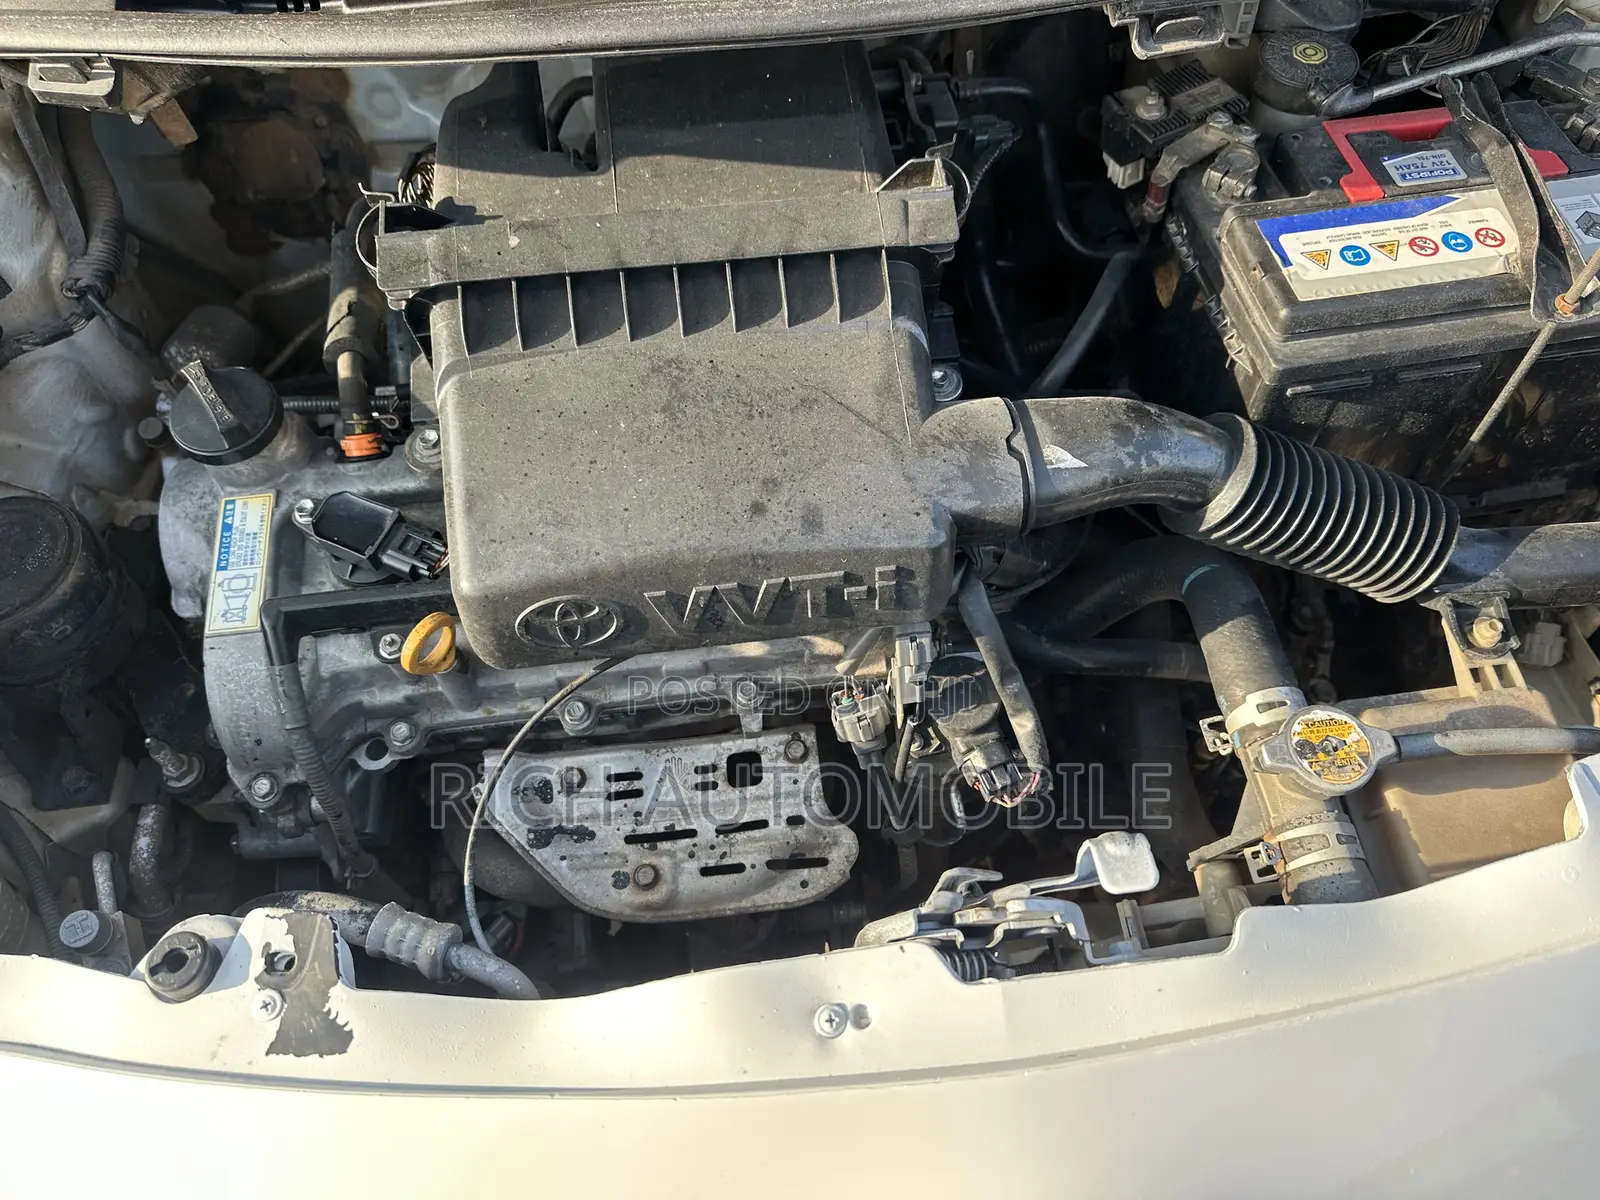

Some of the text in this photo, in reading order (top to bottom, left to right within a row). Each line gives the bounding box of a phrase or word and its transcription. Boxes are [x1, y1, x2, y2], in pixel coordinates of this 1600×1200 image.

[1394, 159, 1452, 172] 12V 75AH
[219, 531, 231, 567] NOTICE
[1308, 719, 1346, 728] CAUTION
